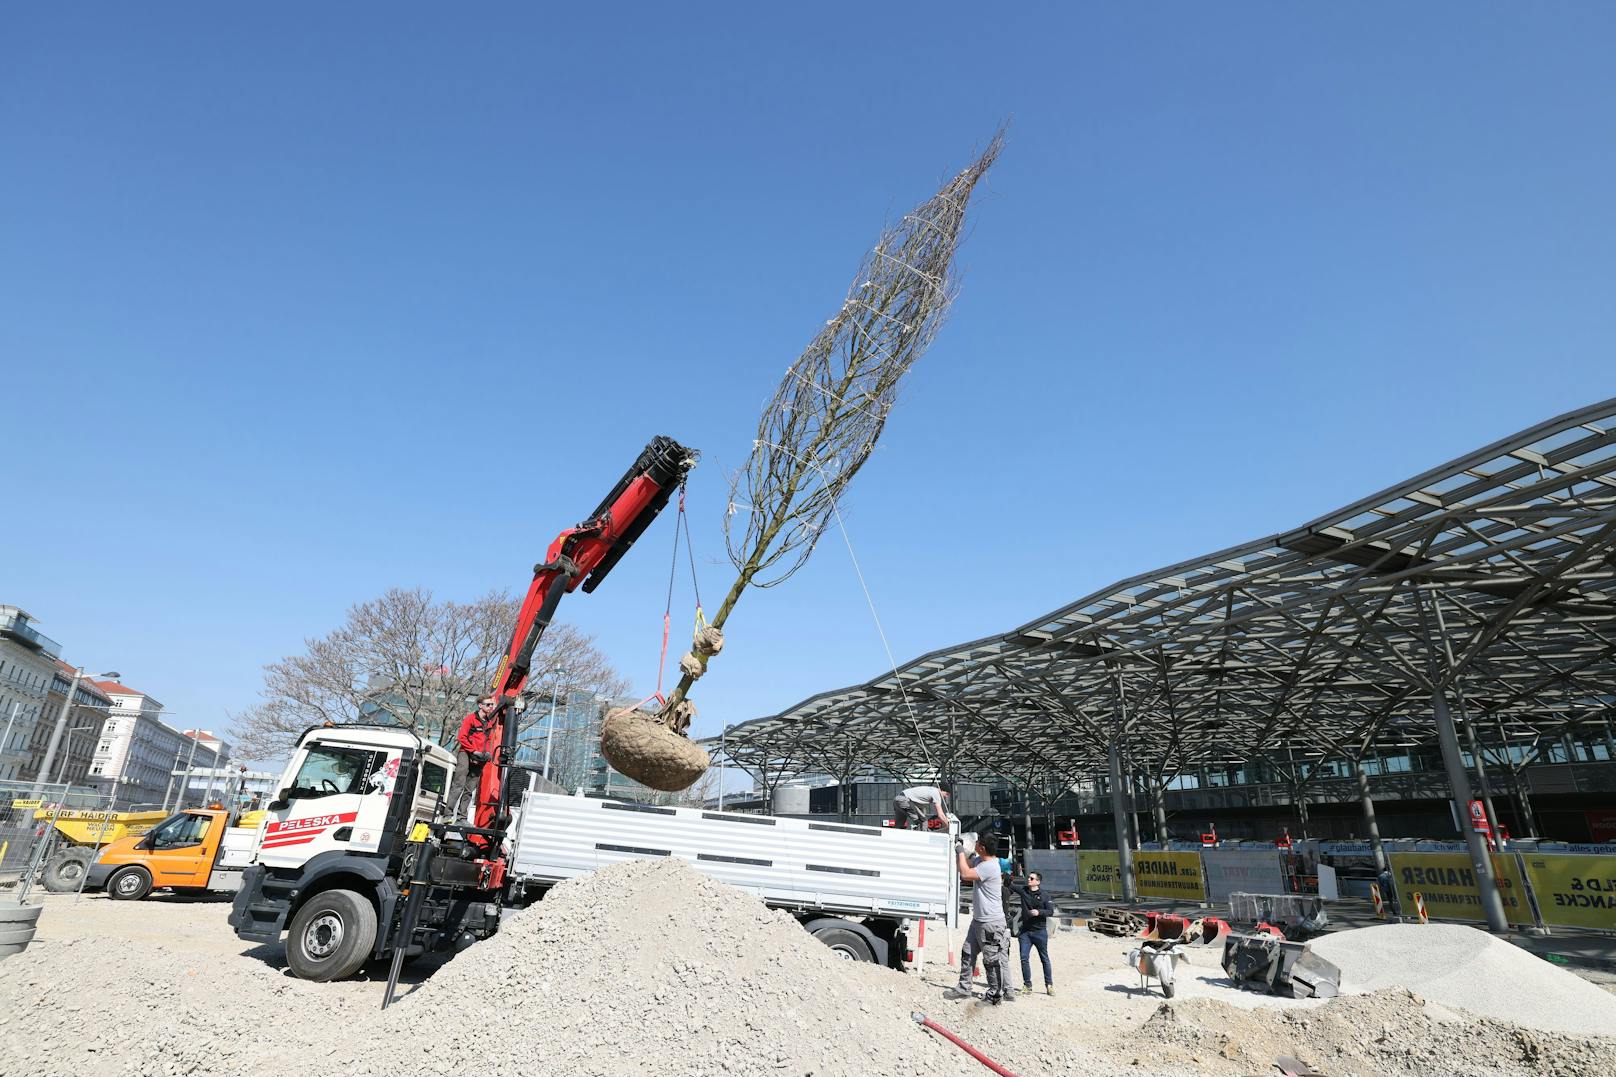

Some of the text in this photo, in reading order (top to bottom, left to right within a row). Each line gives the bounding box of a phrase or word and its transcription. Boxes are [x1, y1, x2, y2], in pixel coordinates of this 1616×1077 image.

[80, 811, 119, 821] HAIDER
[279, 815, 340, 831] PELESKA
[1329, 843, 1372, 852] #glauband
